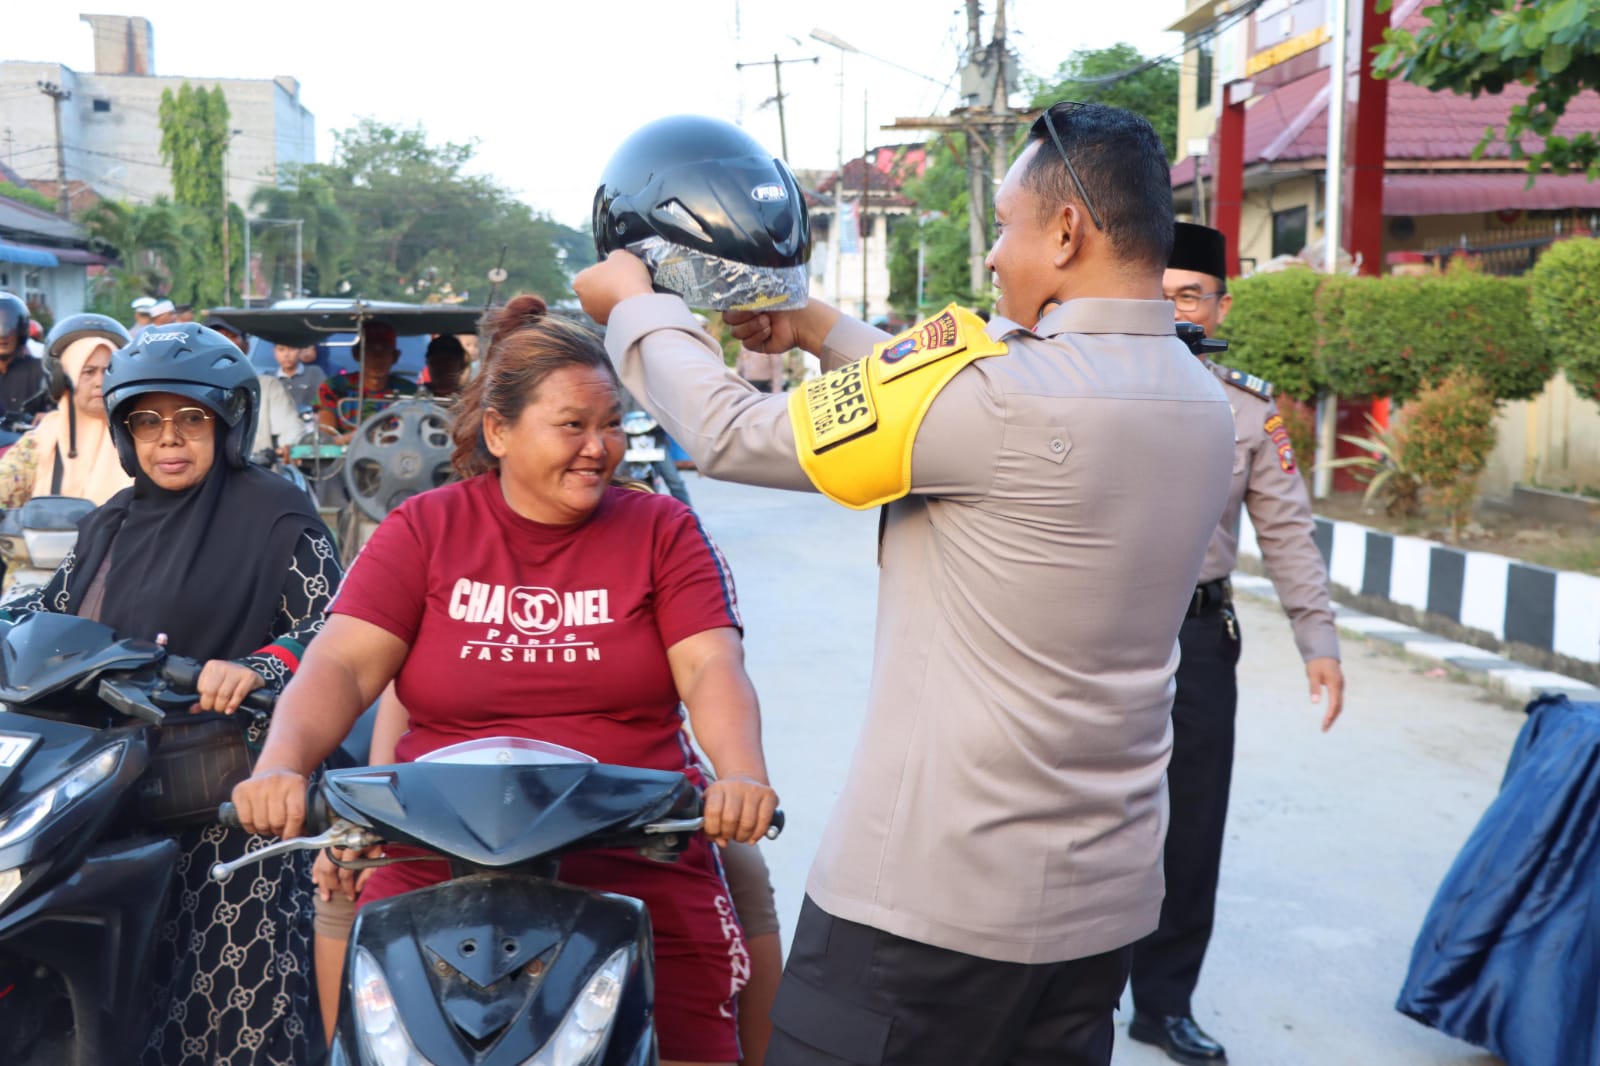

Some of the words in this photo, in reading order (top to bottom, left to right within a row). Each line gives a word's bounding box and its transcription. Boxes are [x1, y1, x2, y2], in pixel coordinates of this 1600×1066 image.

[831, 362, 868, 425] PSRES
[486, 628, 577, 645] PARIS
[460, 645, 600, 663] FASHION
